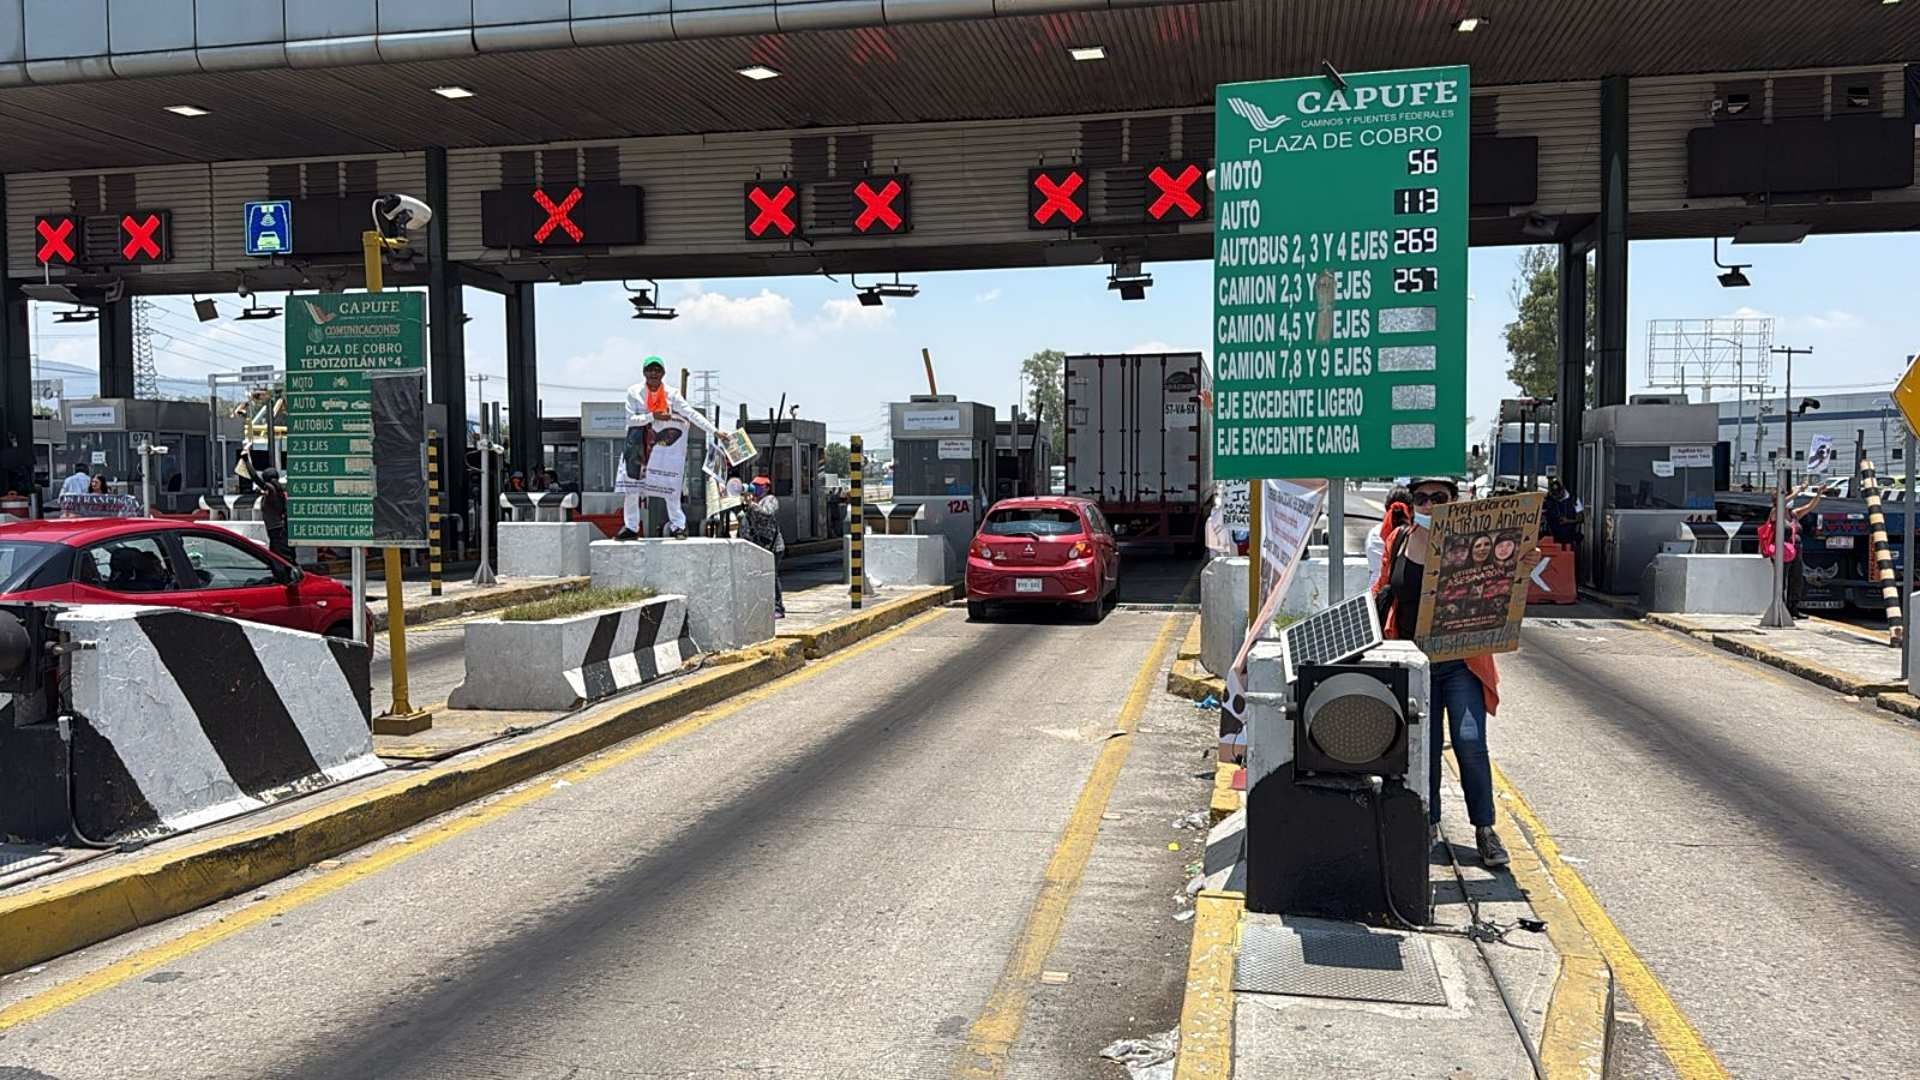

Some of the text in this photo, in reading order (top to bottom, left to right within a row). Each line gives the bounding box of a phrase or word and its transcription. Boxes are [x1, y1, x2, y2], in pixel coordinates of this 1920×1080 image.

[1297, 80, 1458, 114] CAPUFE
[1301, 109, 1454, 128] CAMINOS Y PUENTES FEDERALES
[1249, 125, 1442, 154] PLAZA DE COBRO
[1408, 149, 1438, 175] 56
[1220, 160, 1262, 191] MOTO
[1403, 188, 1439, 214] 113
[1220, 200, 1260, 230] AUTO
[1219, 230, 1388, 269] AUTOBUS 2, 3 Y 4 EJES
[1394, 228, 1438, 255] 269
[1219, 274, 1276, 306] CAMION
[1280, 273, 1302, 309] 2,3
[1307, 273, 1317, 301] Y
[1334, 269, 1371, 300] EJES
[1394, 267, 1438, 293] 257
[339, 301, 400, 314] CAPUFE
[325, 324, 400, 336] COMUNICACIONES
[1218, 314, 1275, 344] CAMION
[1279, 313, 1301, 347] 4,5
[1305, 311, 1316, 340] Y
[1333, 309, 1370, 339] EJES
[306, 343, 402, 355] PLAZA DE COBRO
[1218, 346, 1372, 384] CAMION 7,8 Y 9 EJES
[292, 376, 313, 389] MOTO
[293, 398, 316, 409] AUTO
[1217, 387, 1364, 420] EJE EXCEDENTE LIGERO
[293, 419, 334, 431] AUTOBUS
[309, 440, 329, 452] EJES
[1217, 424, 1360, 456] EJE EXCEDENTE CARGA
[309, 461, 329, 473] EJES
[309, 482, 329, 494] EJES
[293, 503, 373, 515] EJE EXCEDENTE LIGERO
[947, 500, 970, 513] 12A
[293, 524, 374, 536] EJE EXCEDENTE CARGA
[1432, 506, 1540, 537] MALTRATO Animal
